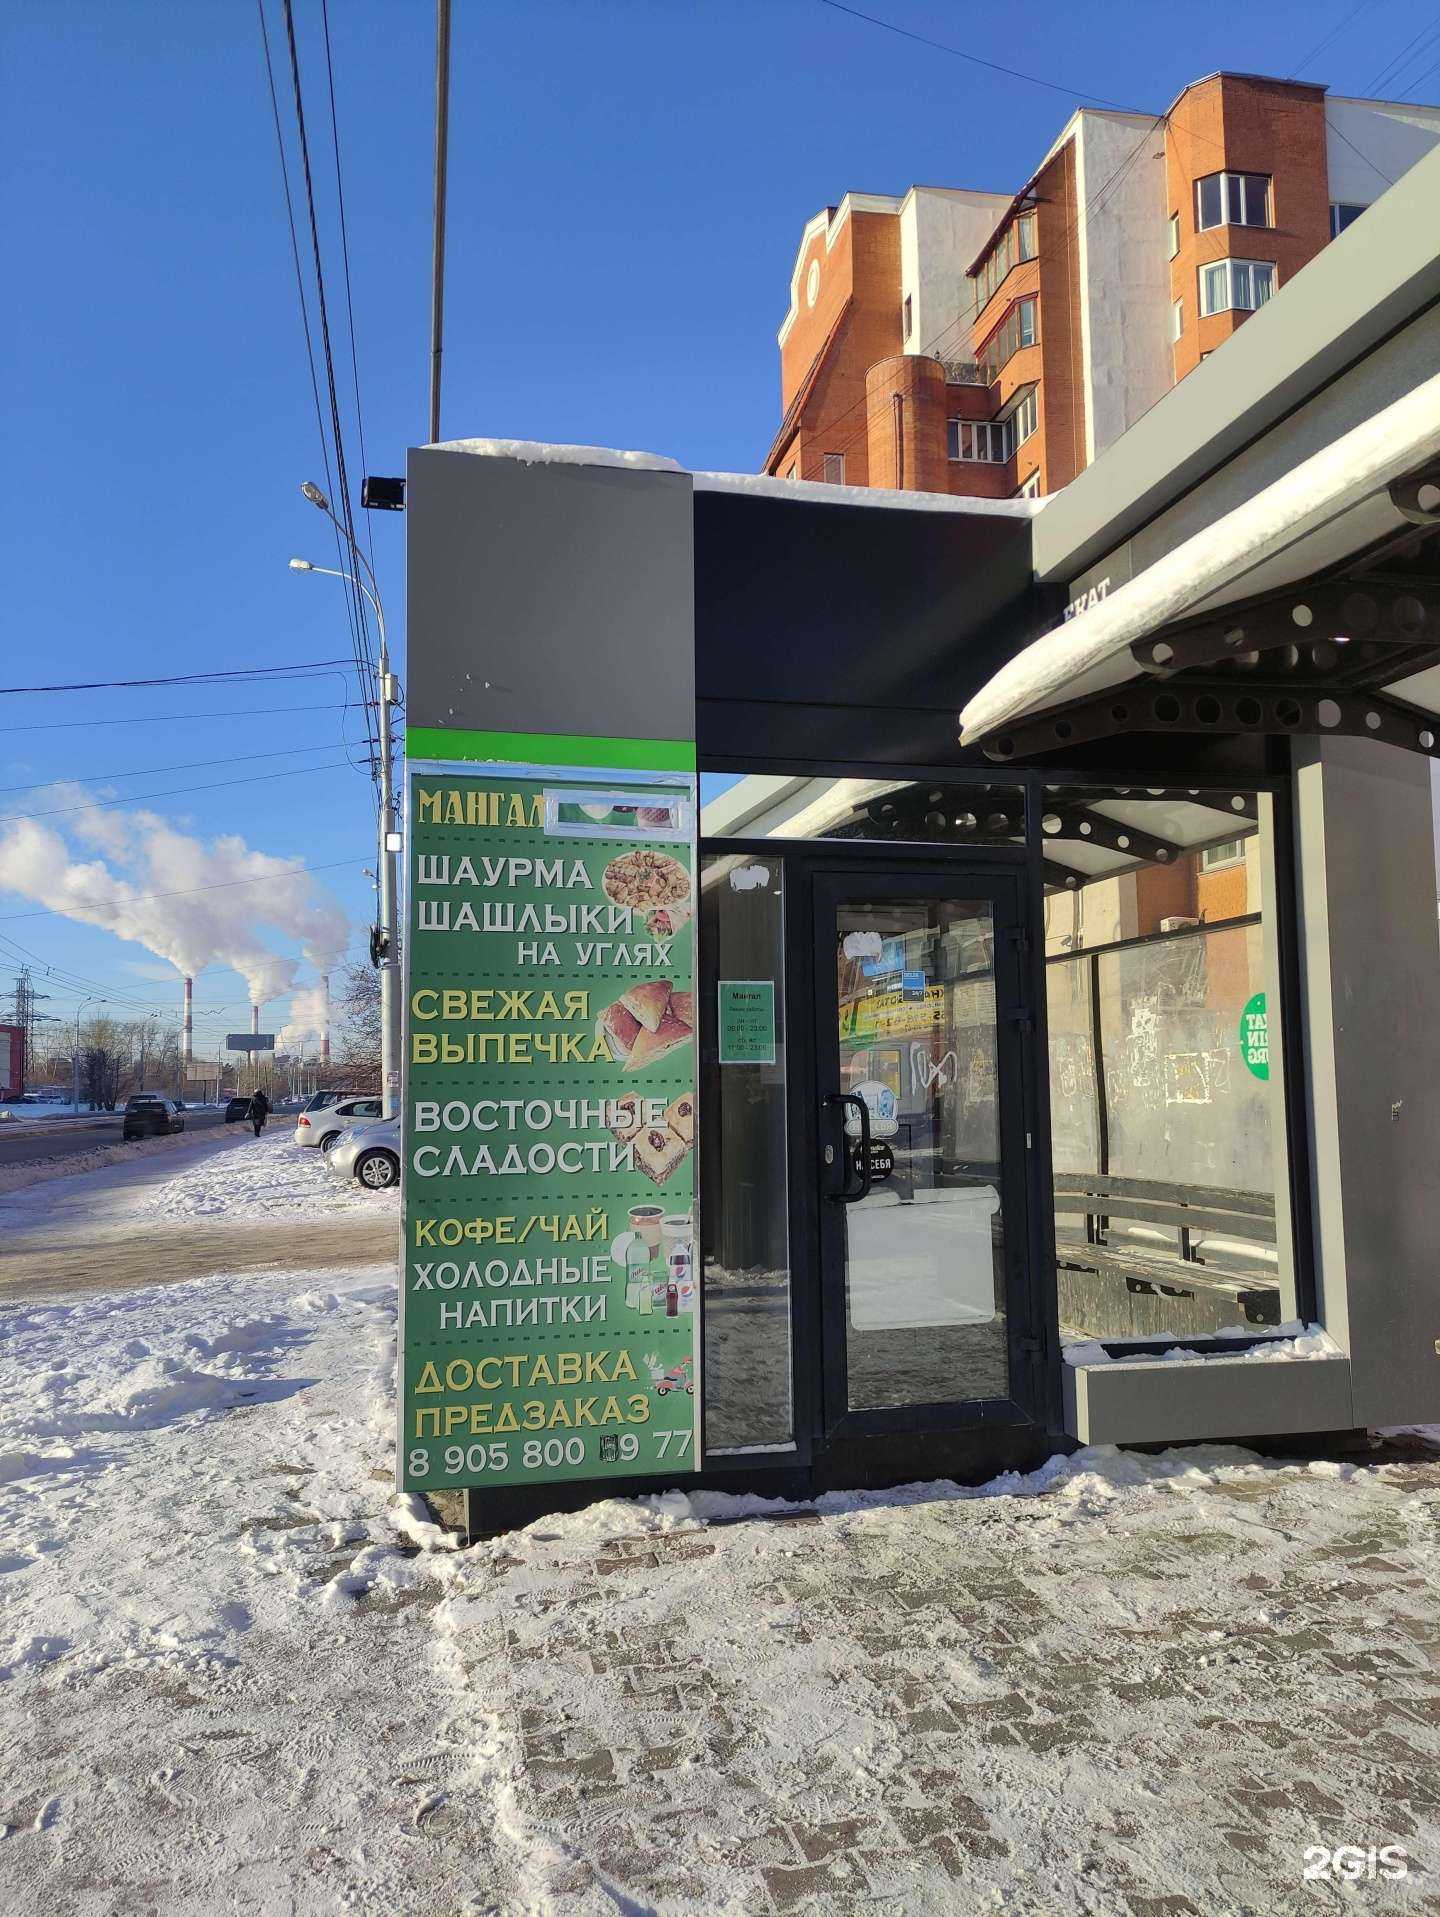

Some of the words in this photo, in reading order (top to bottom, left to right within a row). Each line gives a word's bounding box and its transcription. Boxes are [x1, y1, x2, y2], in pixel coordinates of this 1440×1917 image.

[416, 855, 594, 888] ШАУРМА
[416, 901, 634, 934] ШАШЛЫКИ
[517, 941, 561, 965] НА
[576, 942, 673, 966] УГЛЯХ
[411, 990, 591, 1021] СВЕЖАЯ
[412, 1033, 616, 1064] ВЫПЕЧКА
[415, 1098, 669, 1133] ВОСТОЧНЫЕ
[413, 1142, 637, 1177] СЛАДОСТИ
[415, 1207, 609, 1247] КОФЕ/ЧАЙ
[412, 1255, 613, 1290] ХОЛОДНЫЕ
[439, 1295, 608, 1329] НАПИТКИ
[415, 1349, 638, 1395] ДОСТАВКА
[415, 1394, 651, 1438] ПРЕДЗАКАЗ
[408, 1448, 430, 1477] 8
[444, 1442, 509, 1475] 905
[523, 1436, 586, 1469] 800
[652, 1429, 692, 1460] 77
